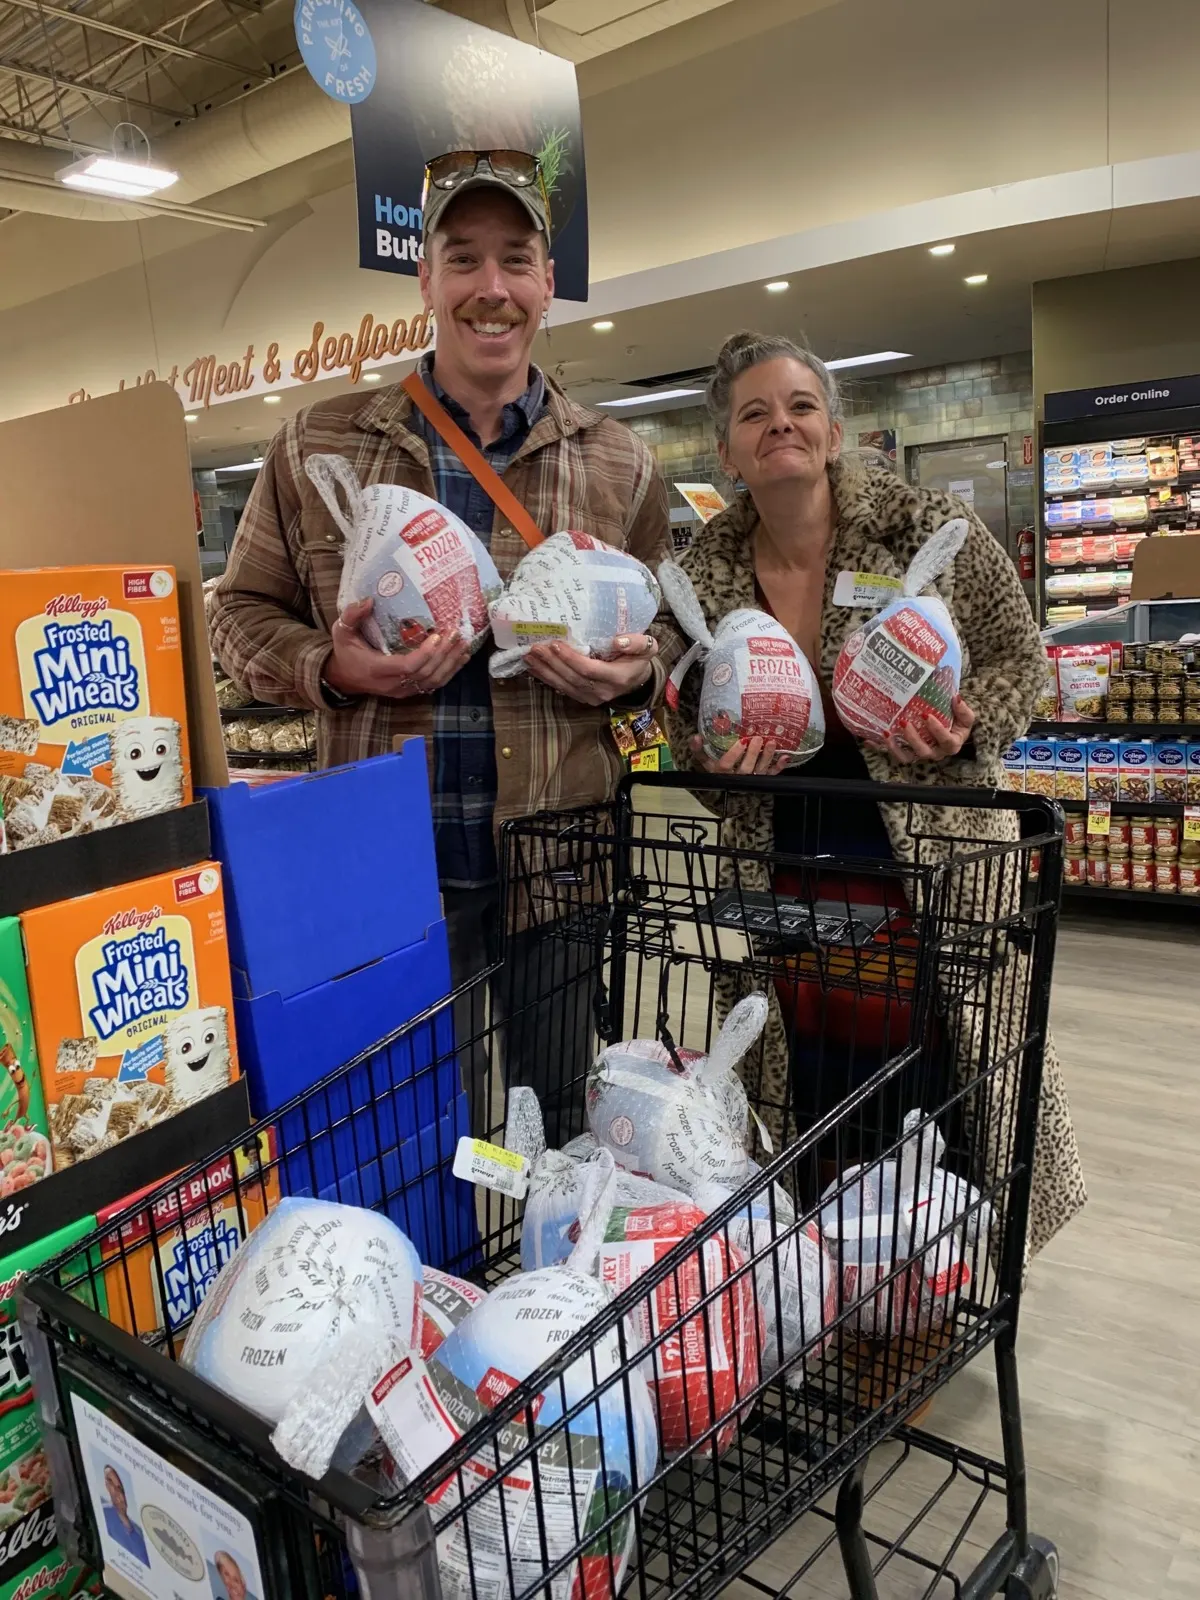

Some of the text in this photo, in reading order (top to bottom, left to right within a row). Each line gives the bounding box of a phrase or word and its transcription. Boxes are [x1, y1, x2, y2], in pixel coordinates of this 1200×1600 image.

[325, 65, 373, 98] FRESH
[183, 344, 254, 409] Meat
[262, 342, 281, 384] &
[290, 312, 432, 385] Seafood
[1095, 388, 1170, 406] Order Online
[377, 504, 394, 537] frozen
[359, 527, 373, 562] frozen
[414, 529, 462, 568] FROZEN
[46, 595, 108, 618] Kellogg's
[47, 624, 111, 649] Frosted
[731, 616, 757, 633] frozen
[758, 621, 778, 632] froze
[896, 611, 946, 654] SHADY BROOK
[898, 625, 922, 647] FARMS
[37, 639, 130, 690] Mini
[749, 659, 801, 677] FROZEN
[874, 639, 917, 677] FROZEN
[34, 671, 137, 723] Wheats
[70, 713, 117, 730] ORIGINAL
[179, 880, 195, 890] HIGH
[179, 886, 197, 896] FIBER
[103, 906, 163, 935] Kellogg's
[105, 930, 165, 966] Frosted
[96, 944, 180, 1006] Mini
[92, 975, 188, 1037] Wheats
[126, 1014, 168, 1037] ORIGINAL
[665, 1132, 688, 1164] frozen
[700, 1150, 726, 1168] frozen
[662, 1162, 693, 1188] frozen
[707, 1172, 744, 1184] frozen
[515, 1308, 562, 1320] FROZEN
[240, 1348, 288, 1367] FROZEN
[375, 1378, 391, 1399] SHADY
[486, 1376, 512, 1395] SHADY
[438, 1388, 475, 1425] FROZEN
[83, 1405, 103, 1429] Local
[104, 1423, 131, 1447] experts
[165, 1469, 174, 1481] in
[175, 1476, 190, 1490] our
[191, 1487, 243, 1532] community.
[95, 1426, 110, 1446] Put
[109, 1441, 122, 1456] our
[124, 1449, 165, 1487] experience
[166, 1483, 176, 1495] to
[177, 1491, 200, 1513] work
[200, 1505, 214, 1524] for
[215, 1517, 236, 1539] you.
